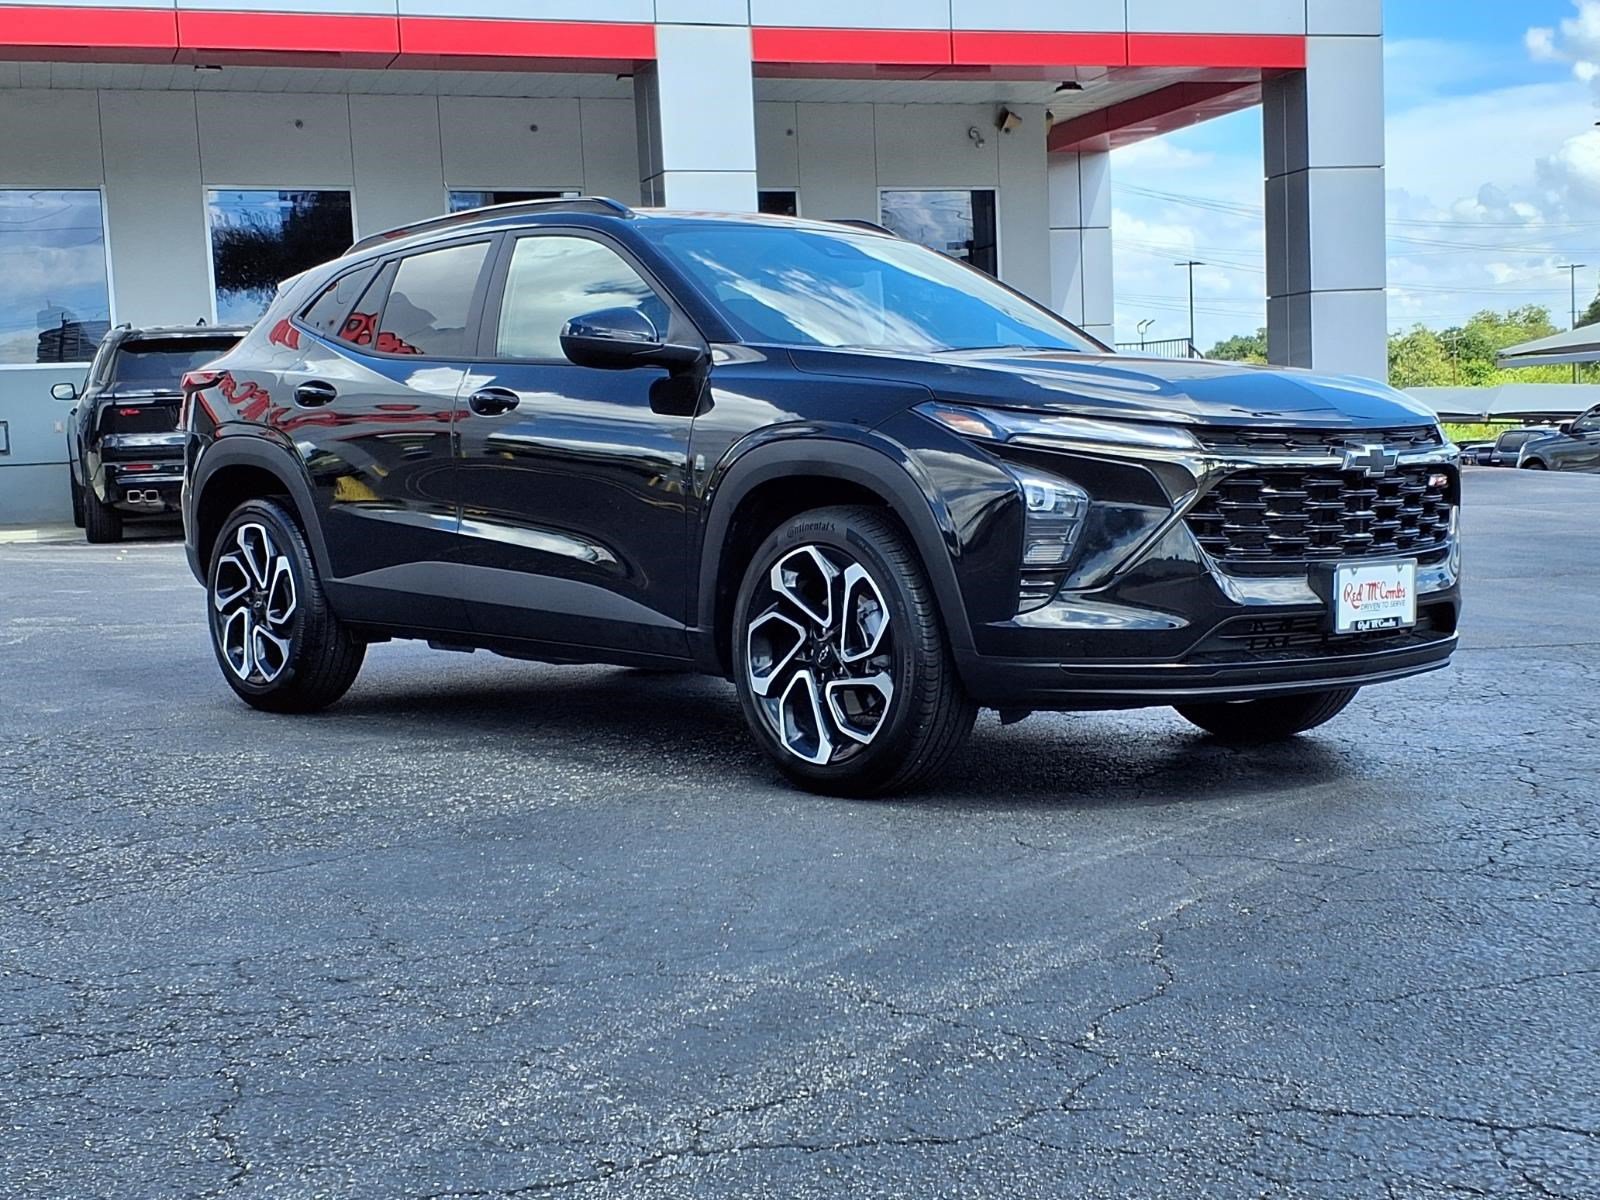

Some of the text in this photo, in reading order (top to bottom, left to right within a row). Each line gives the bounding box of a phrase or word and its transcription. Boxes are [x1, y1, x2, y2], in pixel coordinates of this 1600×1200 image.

[1344, 581, 1405, 609] Red McCombs
[1361, 602, 1380, 610] DRIVEN
